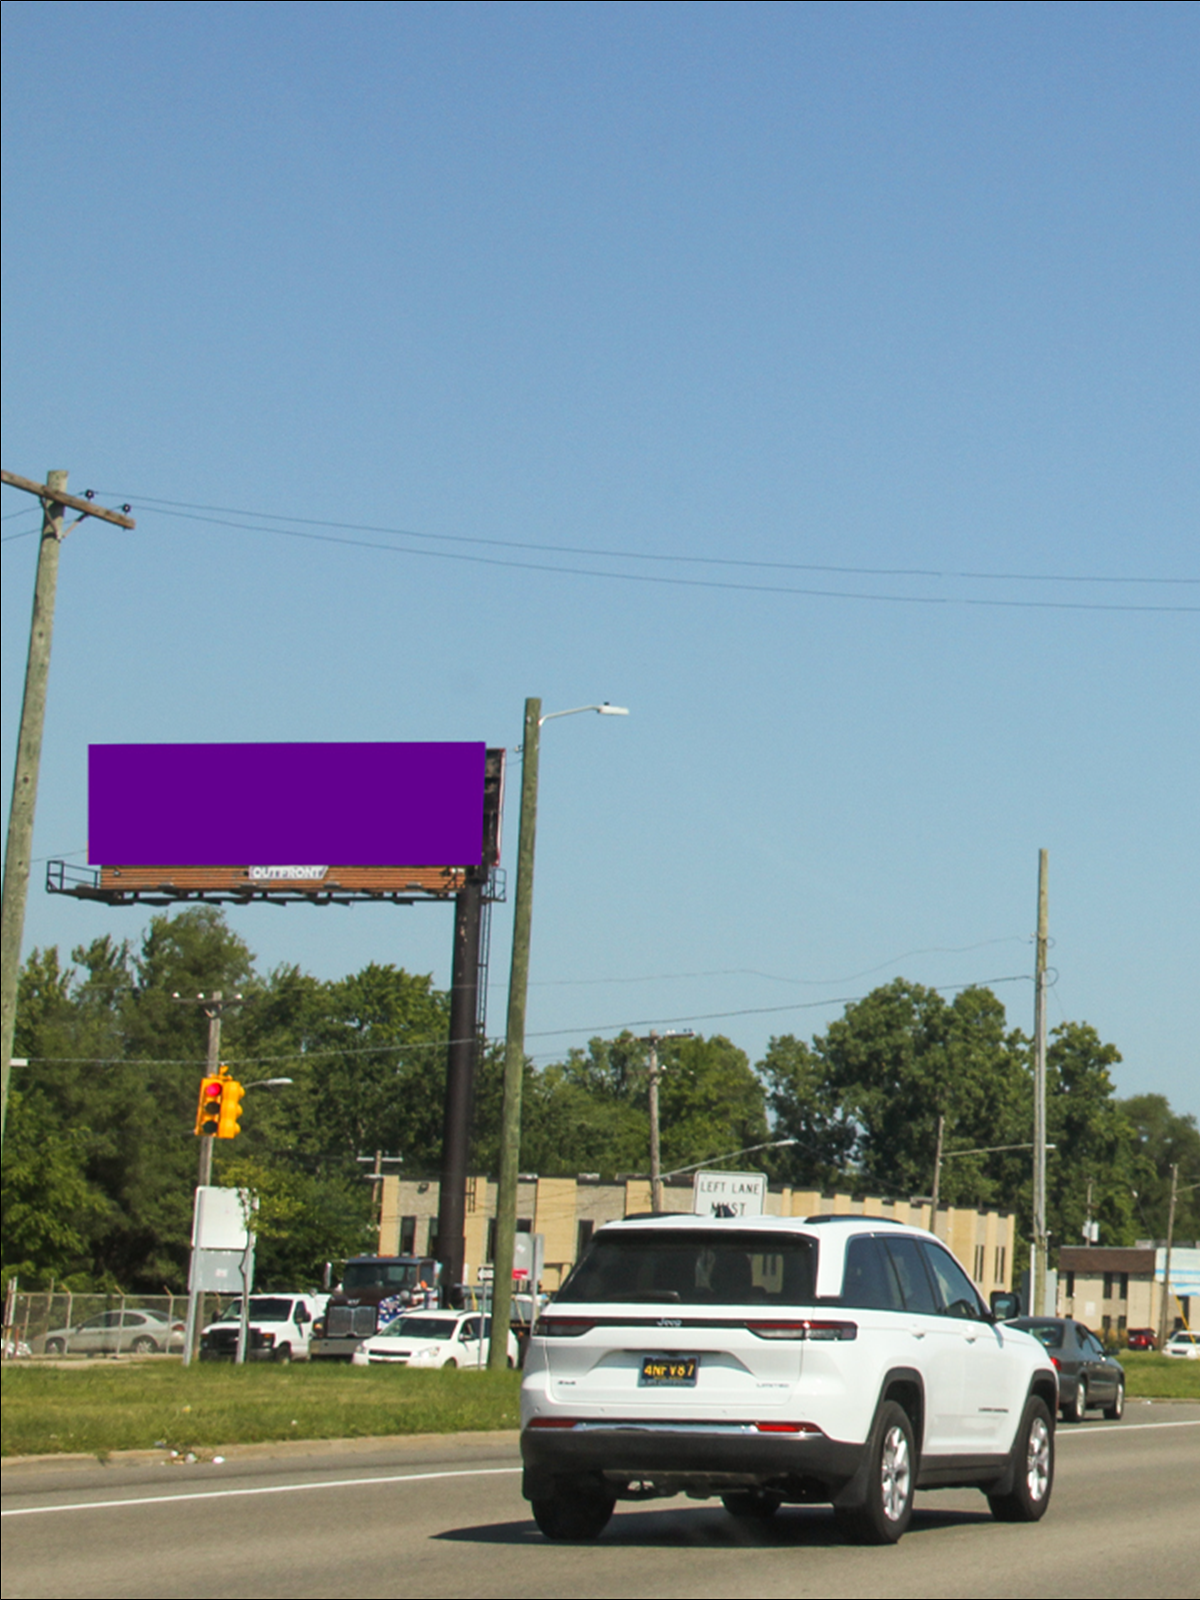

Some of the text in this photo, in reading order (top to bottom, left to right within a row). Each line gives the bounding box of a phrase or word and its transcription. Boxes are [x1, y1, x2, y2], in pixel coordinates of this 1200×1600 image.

[253, 866, 322, 878] OUTFRONT
[701, 1181, 760, 1195] LEFT LANE
[711, 1201, 746, 1216] MST
[656, 1318, 682, 1327] Jeep
